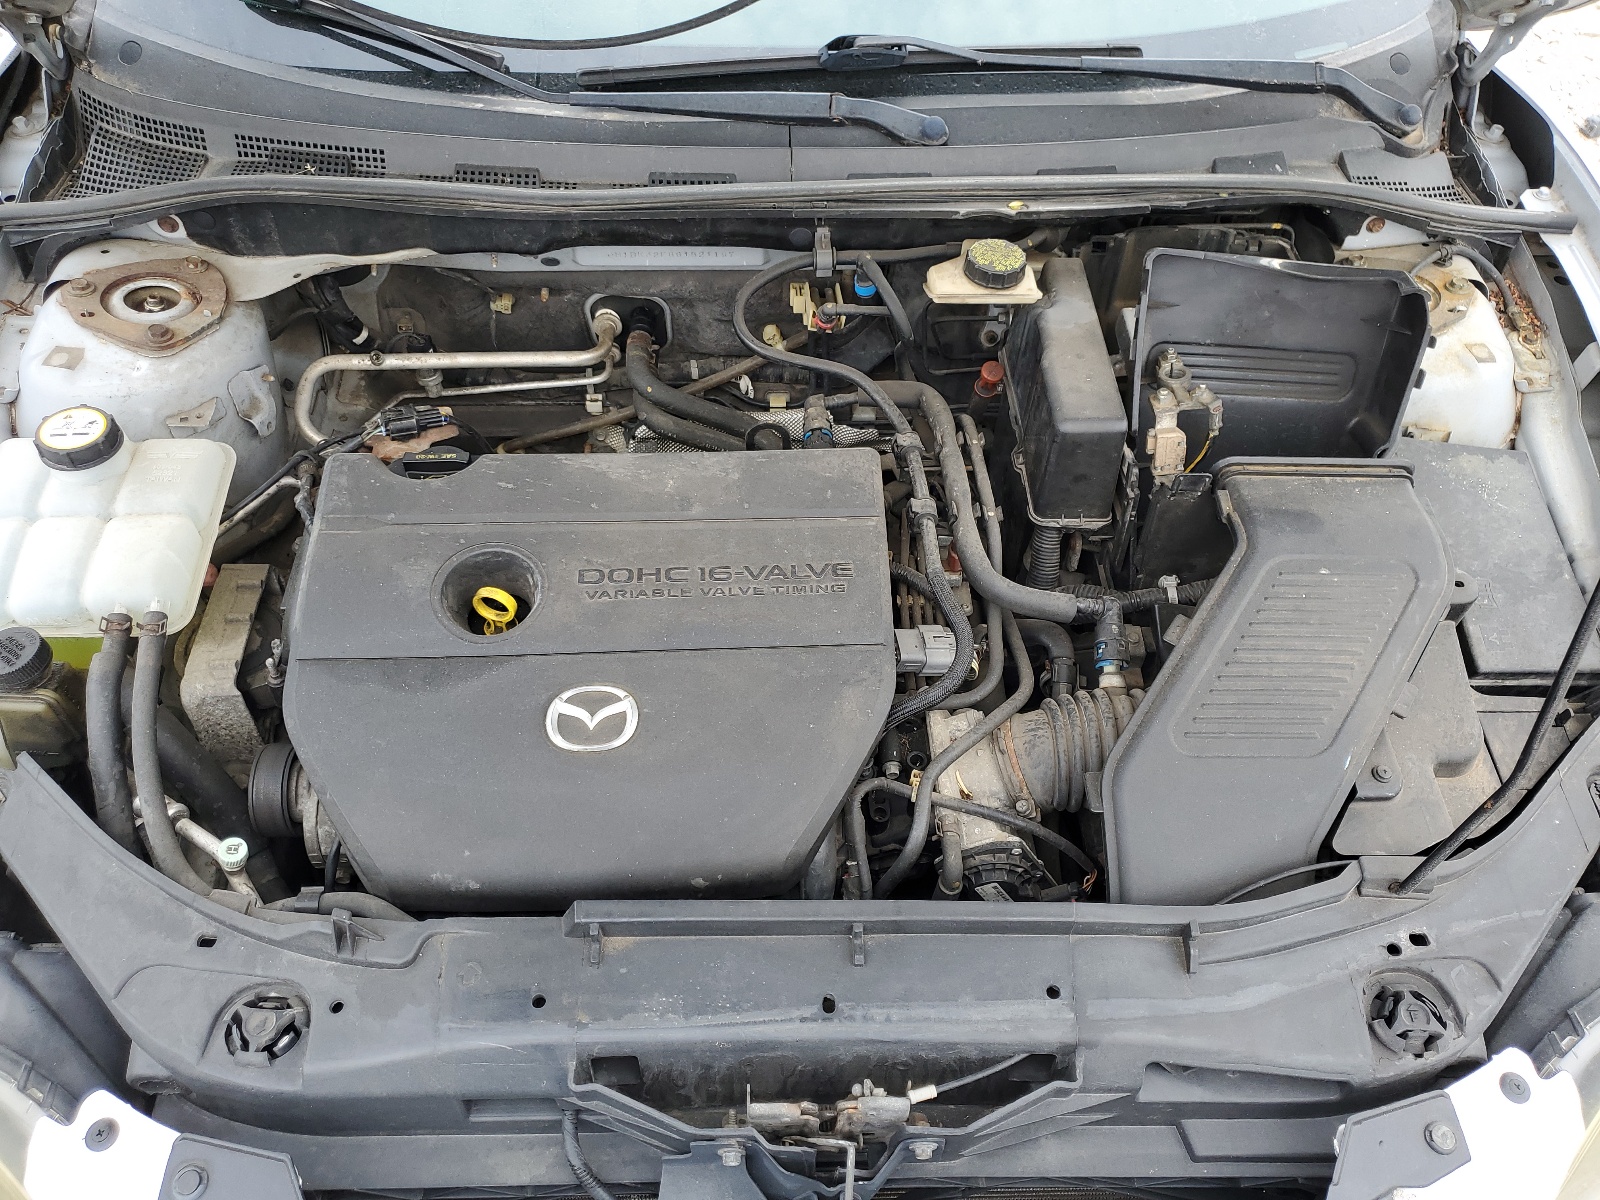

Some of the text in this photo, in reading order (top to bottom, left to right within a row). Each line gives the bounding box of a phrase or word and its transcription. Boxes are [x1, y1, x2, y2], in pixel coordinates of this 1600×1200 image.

[577, 562, 854, 585] DOHC 16-VALVE
[585, 583, 846, 600] VARIABLE VALVE TIMING
